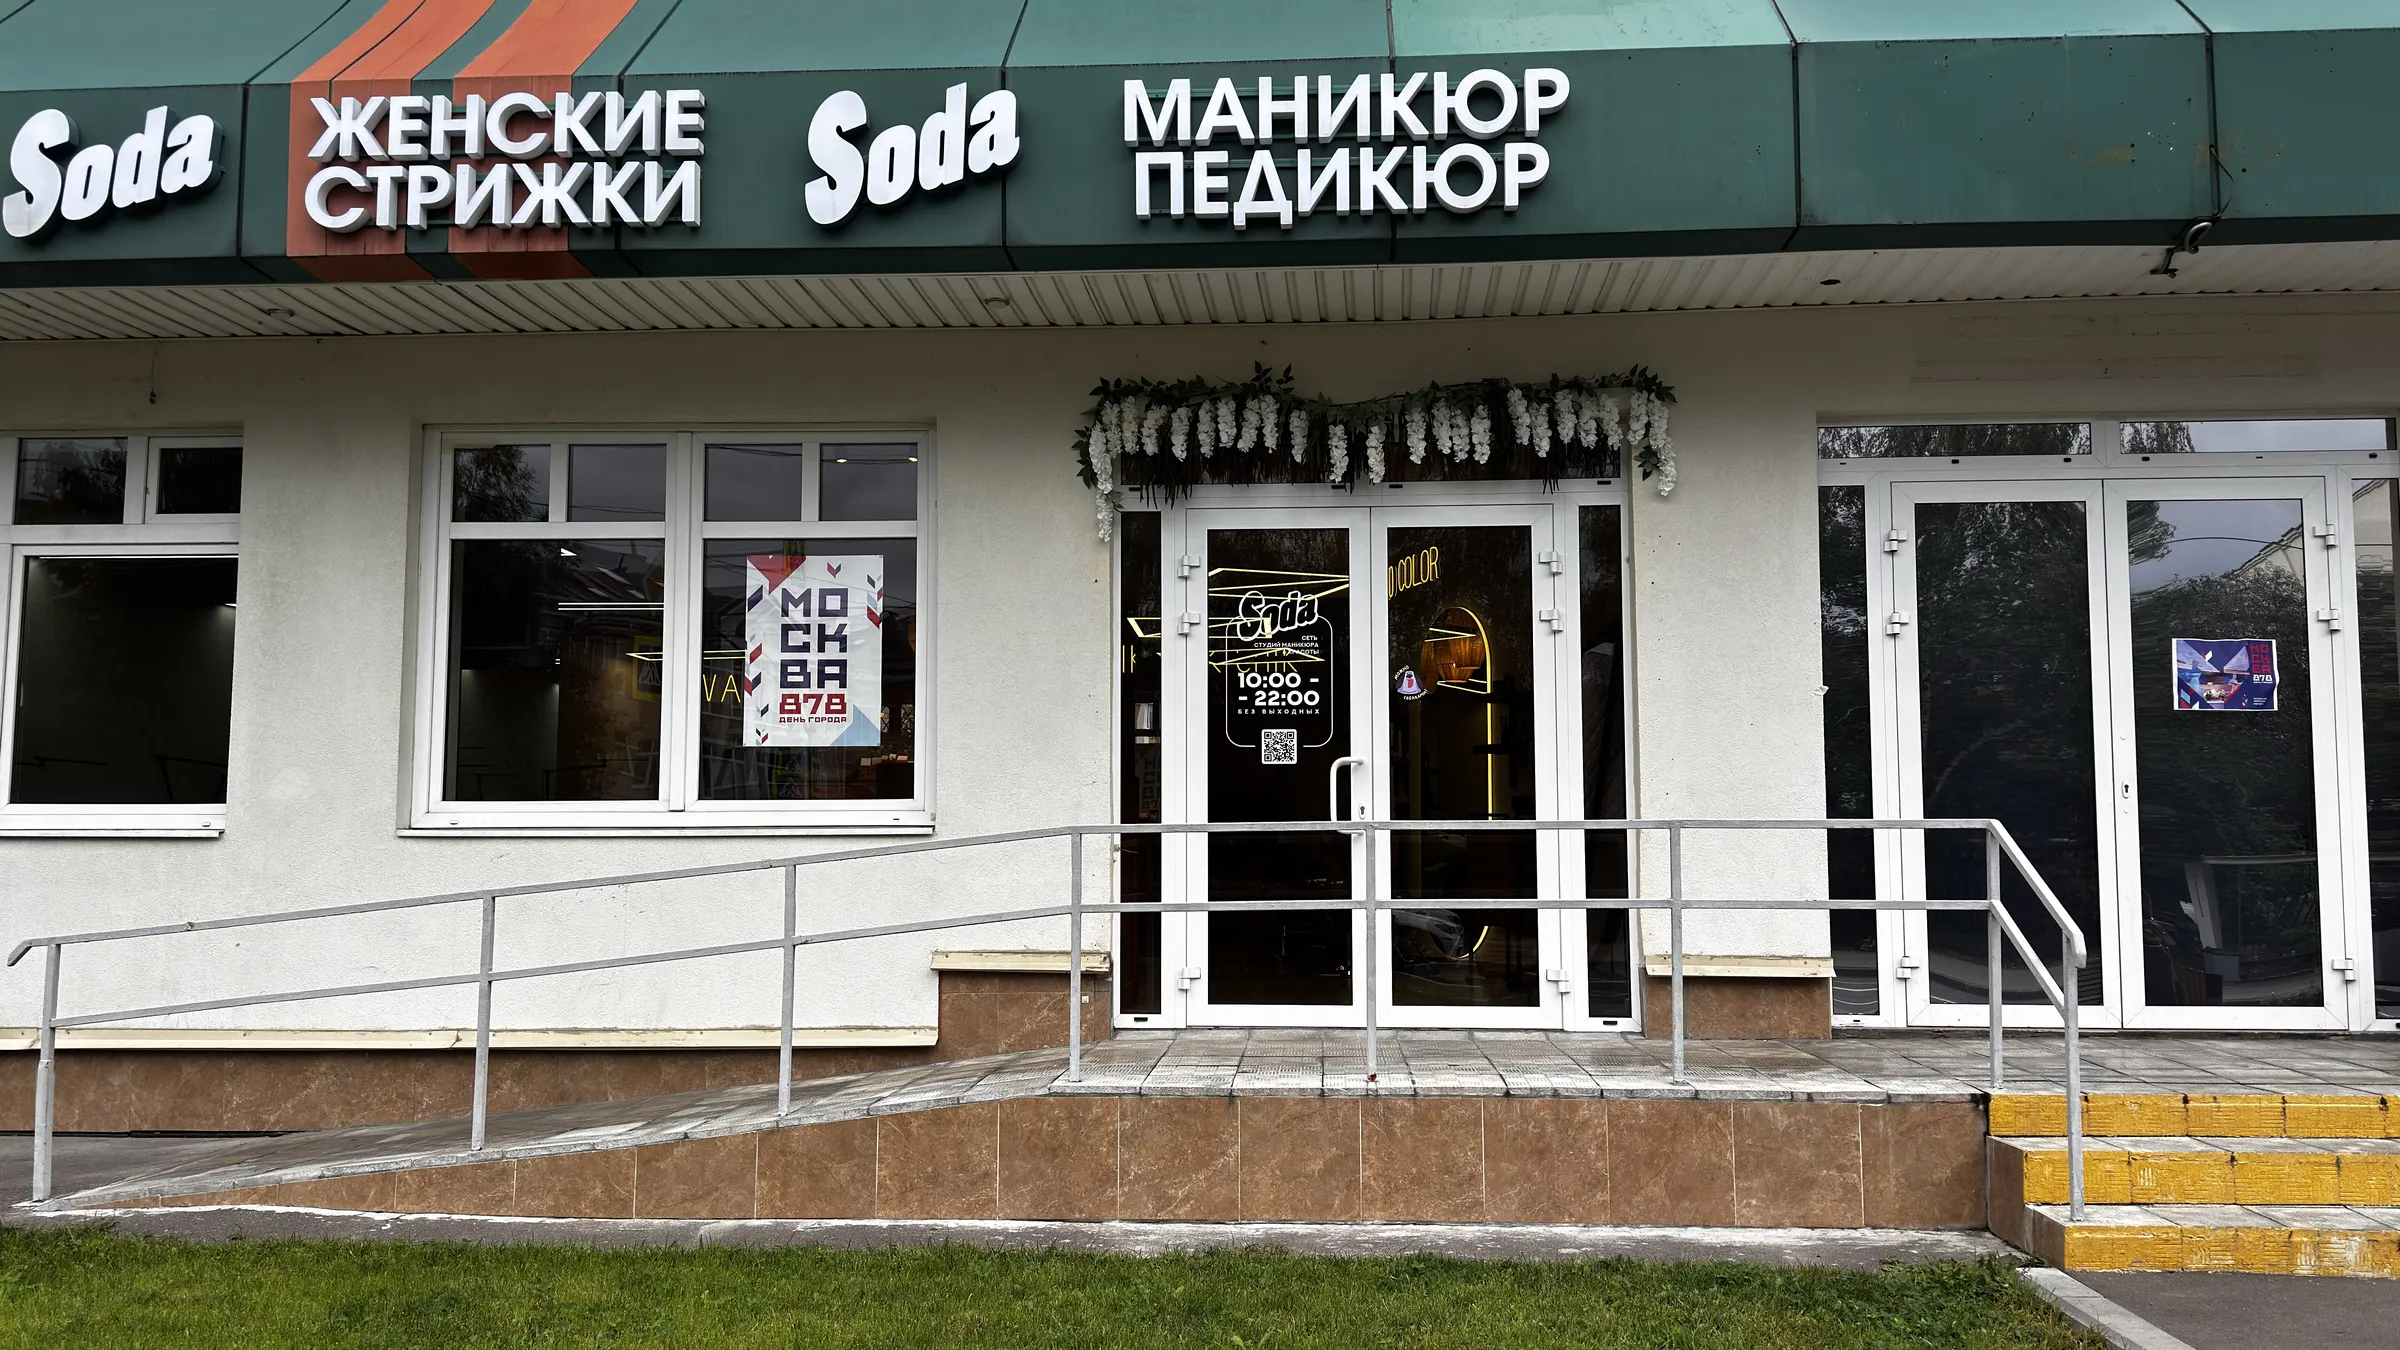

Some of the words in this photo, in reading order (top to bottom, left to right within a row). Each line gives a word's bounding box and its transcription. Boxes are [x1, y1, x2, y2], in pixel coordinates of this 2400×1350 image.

[308, 89, 705, 162] ЖЕНСКИЕ
[1123, 67, 1571, 149] МАНИКЮР
[2, 105, 217, 240] Soda
[804, 82, 1020, 227] Soda
[305, 160, 702, 232] СТРИЖКИ
[1134, 142, 1550, 231] ПЕДИКЮР
[1397, 546, 1440, 592] COLOR
[781, 587, 849, 618] МО
[1236, 590, 1319, 642] Soda
[780, 623, 848, 654] СК
[779, 659, 848, 689] ВА
[1237, 672, 1302, 689] 10:00
[2253, 674, 2273, 682] 878
[779, 693, 847, 715] 878
[1254, 690, 1320, 706] 22:00
[779, 716, 806, 724] ДЕНЬ
[808, 716, 847, 724] ГОРОДА
